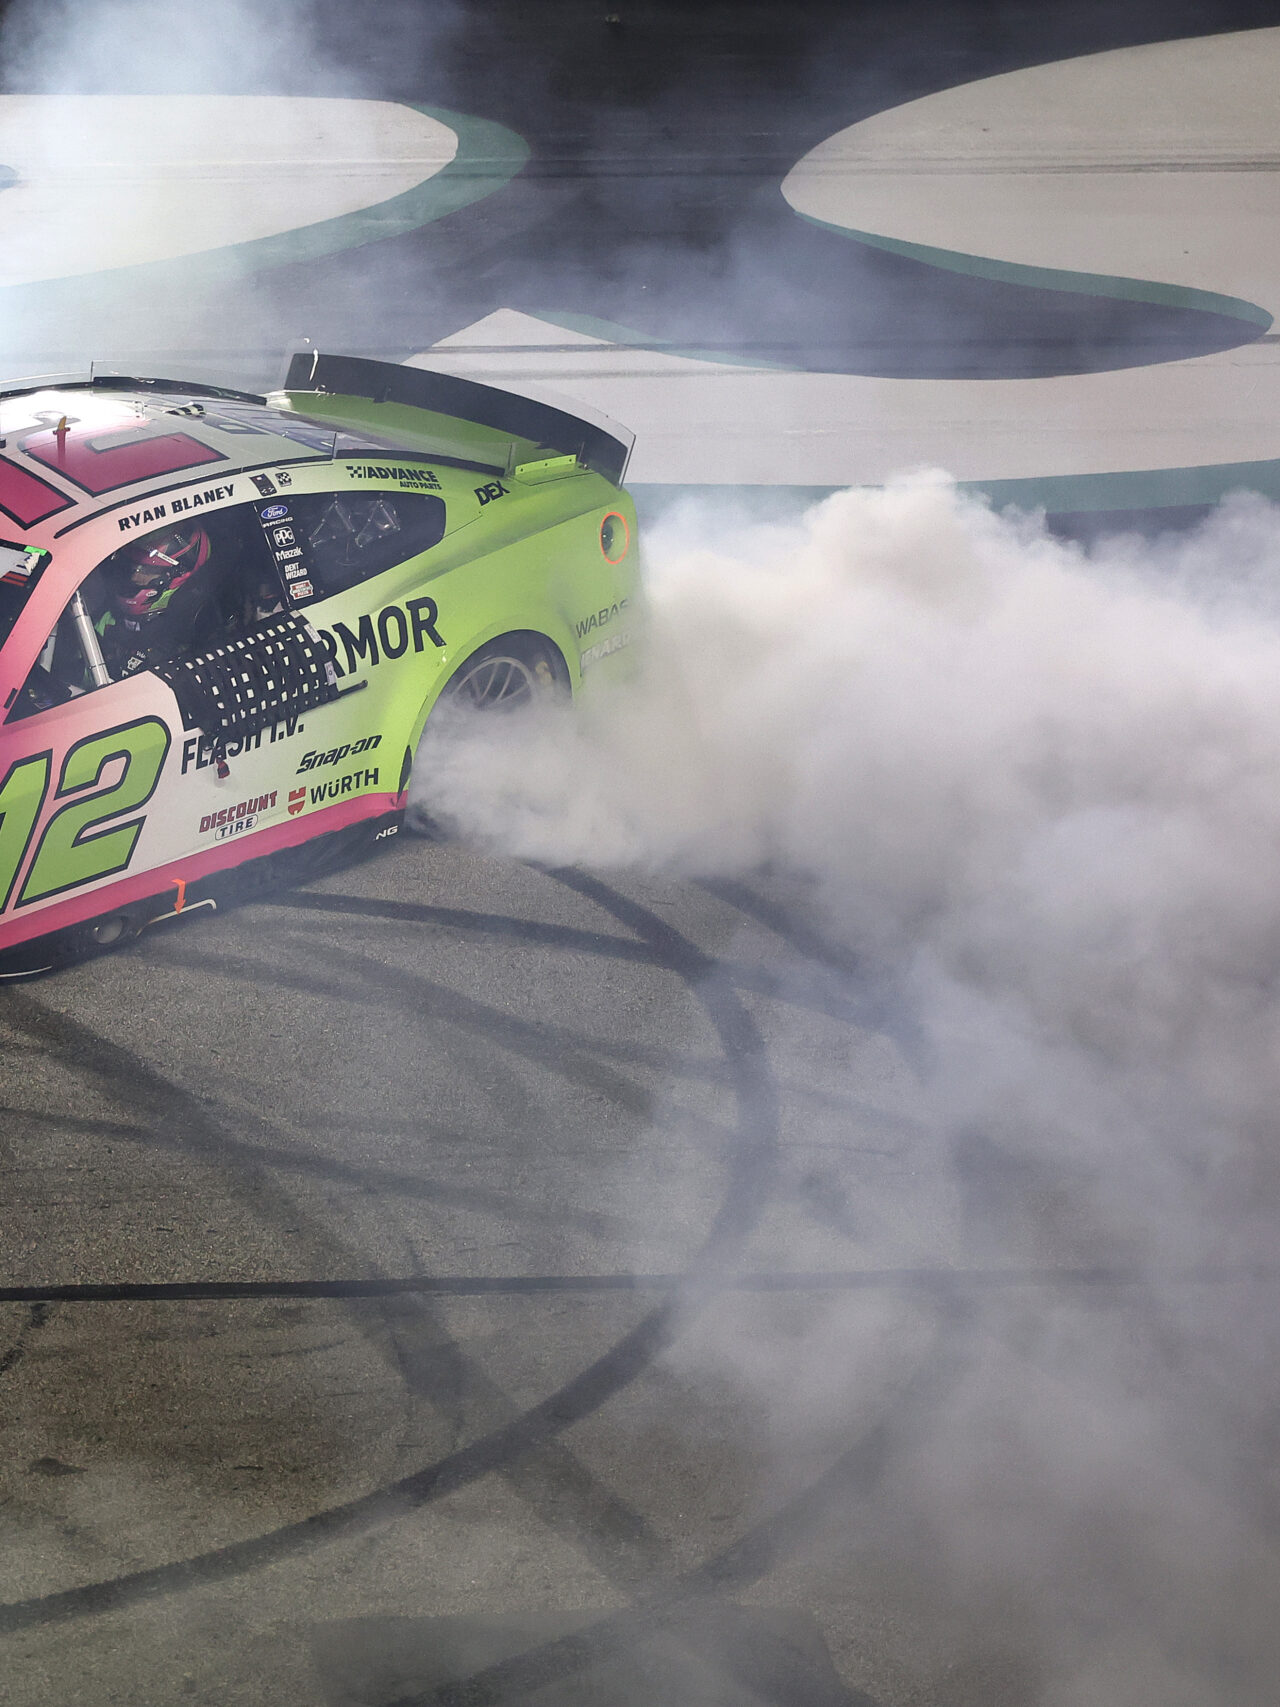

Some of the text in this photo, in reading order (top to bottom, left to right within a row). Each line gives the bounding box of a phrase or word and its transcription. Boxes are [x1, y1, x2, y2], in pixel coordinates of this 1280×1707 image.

[368, 466, 440, 483] ADVANCE
[400, 480, 443, 491] AUTO PARTS
[473, 480, 511, 507] DEX
[118, 484, 235, 532] RYAN BLANEY
[274, 529, 294, 545] PPG
[275, 546, 304, 562] Mazak
[198, 790, 278, 833] DISCOUNT
[218, 817, 255, 839] TIRE
